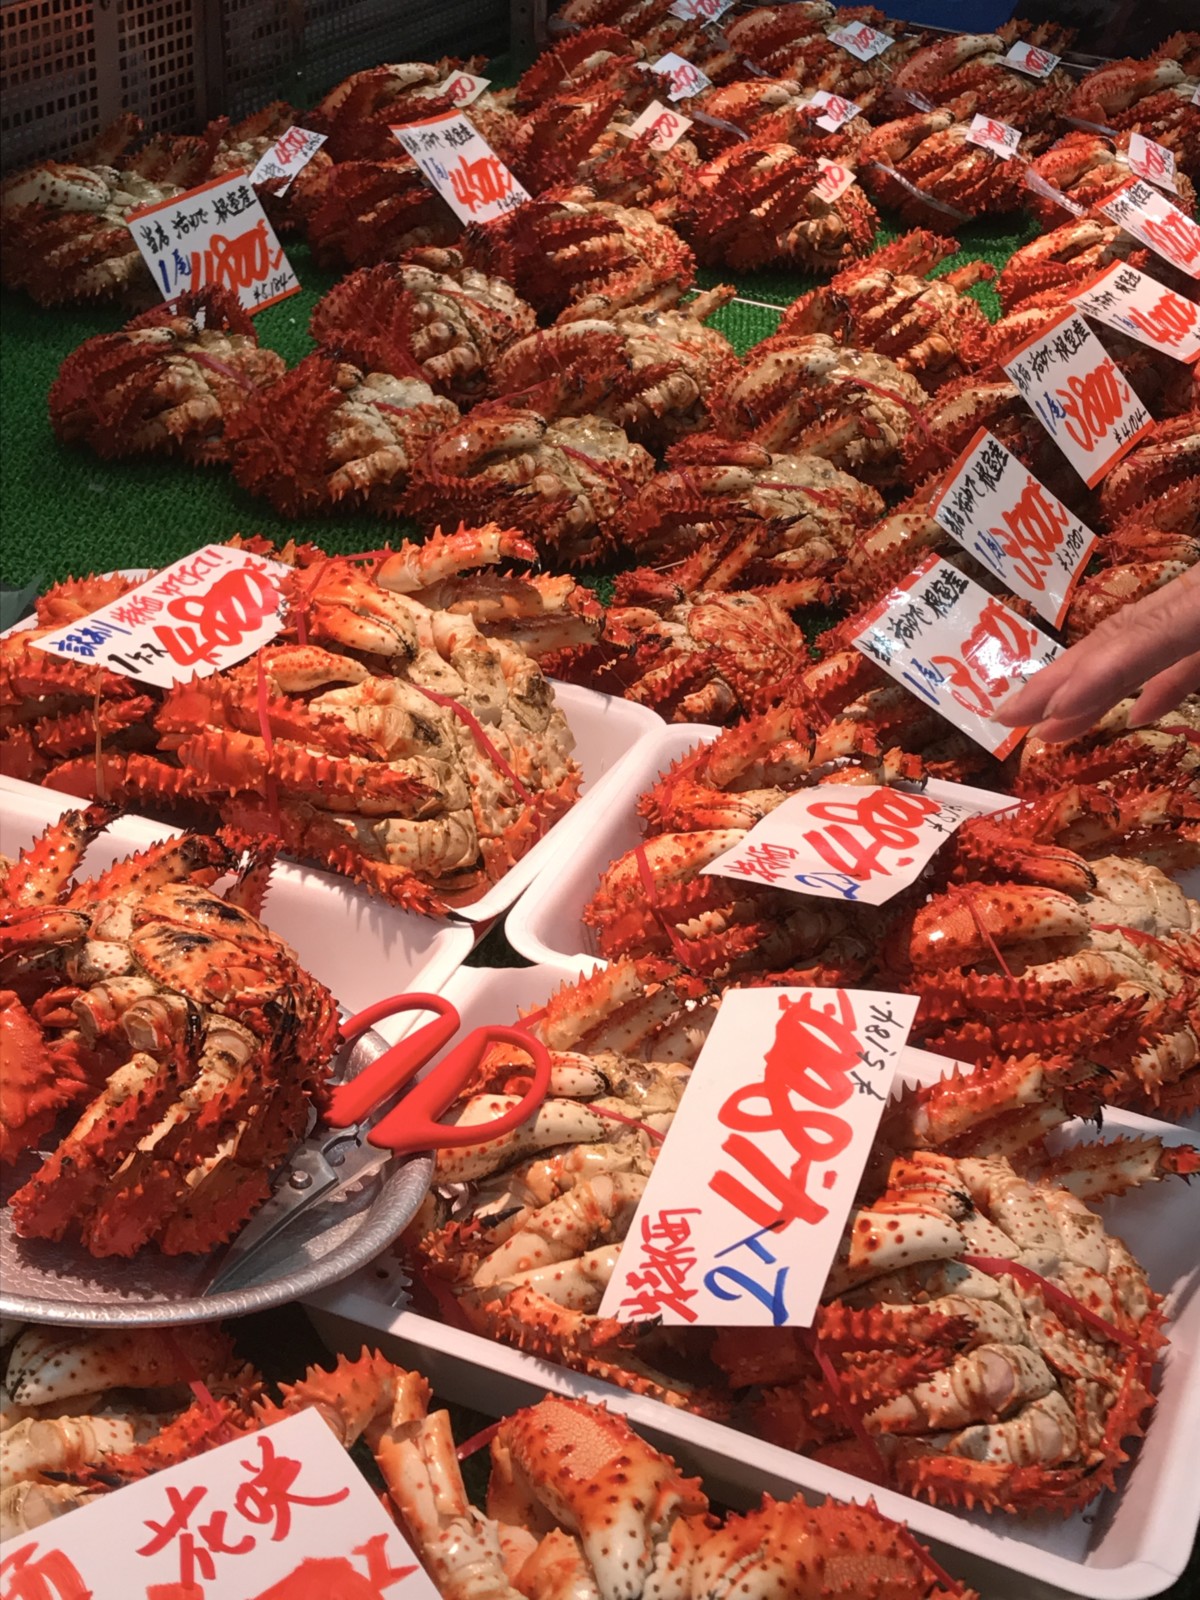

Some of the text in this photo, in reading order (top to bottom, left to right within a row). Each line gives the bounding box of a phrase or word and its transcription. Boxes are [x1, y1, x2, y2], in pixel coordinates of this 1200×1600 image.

[1052, 319, 1090, 363] 根室産
[971, 439, 1010, 497] 根室産
[924, 568, 969, 620] 根室産
[135, 1435, 350, 1590] 花咲
